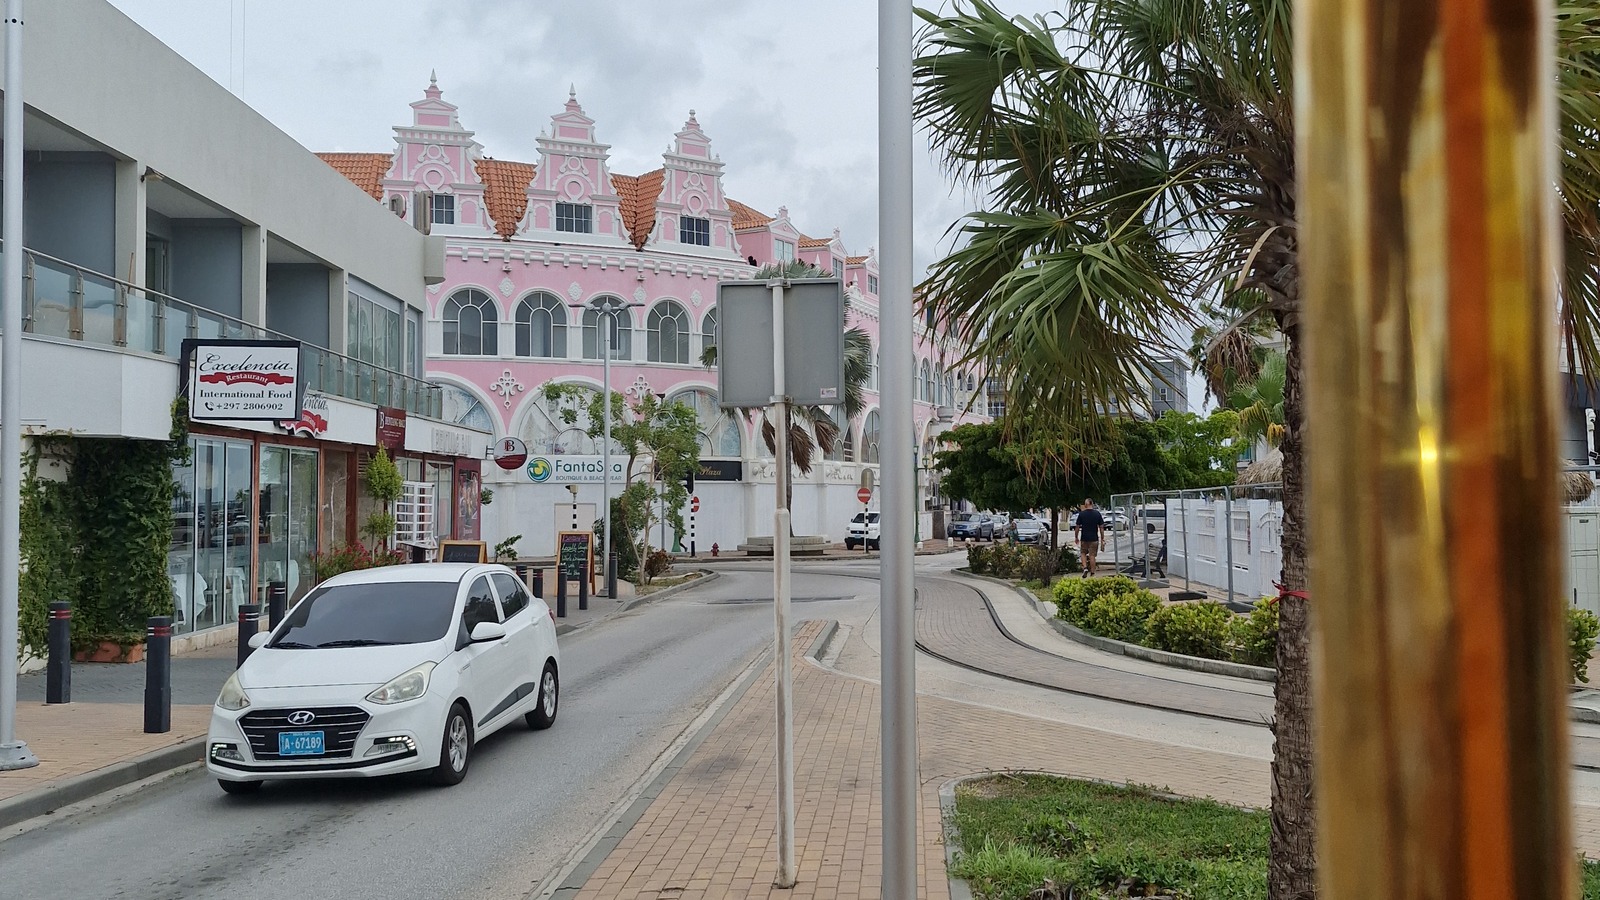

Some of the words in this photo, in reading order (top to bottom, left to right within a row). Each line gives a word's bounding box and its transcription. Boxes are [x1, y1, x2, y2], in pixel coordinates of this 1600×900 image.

[226, 373, 268, 383] Restaurant
[200, 390, 264, 398] International
[268, 390, 292, 398] Food
[556, 460, 622, 473] FantaSa
